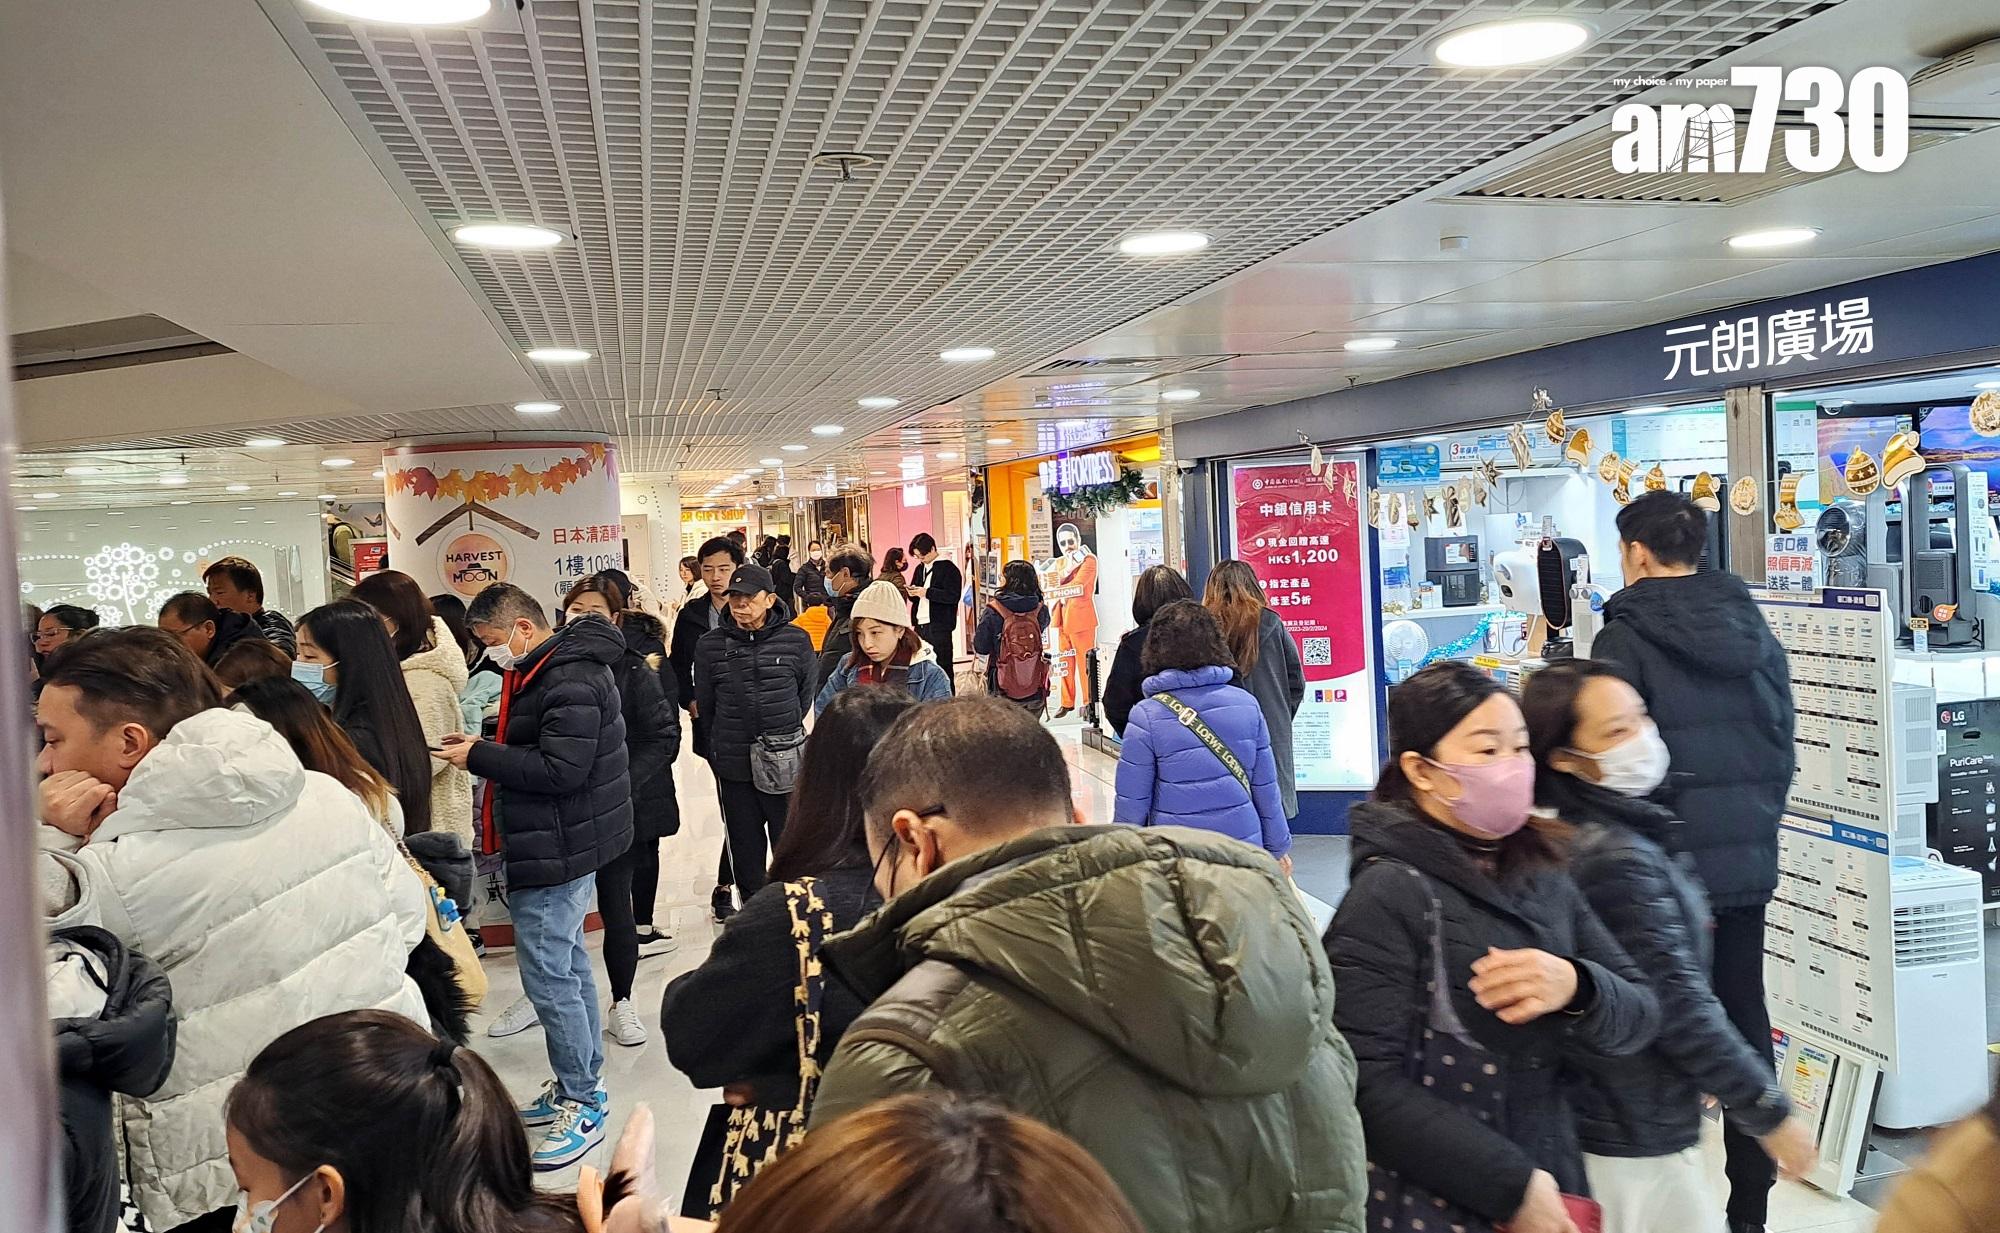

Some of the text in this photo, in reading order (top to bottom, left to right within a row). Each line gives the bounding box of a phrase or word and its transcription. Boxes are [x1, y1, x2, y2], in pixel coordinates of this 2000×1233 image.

[1664, 296, 1874, 380] 元朗廣場
[1070, 451, 1115, 487] FORTRESS
[1259, 500, 1332, 517] 中銀信用卡
[1773, 536, 1809, 552] 窗口機
[446, 550, 504, 563] HARVEST
[1268, 549, 1339, 565] HK$1,200
[1767, 556, 1813, 572] 照價再減
[453, 570, 498, 583] MOON
[1269, 577, 1311, 589] 指定產品
[1269, 591, 1312, 606] 低至5折
[1952, 711, 1965, 722] LG
[1196, 724, 1225, 754] LOEWE
[1950, 757, 1984, 769] PuriCare
